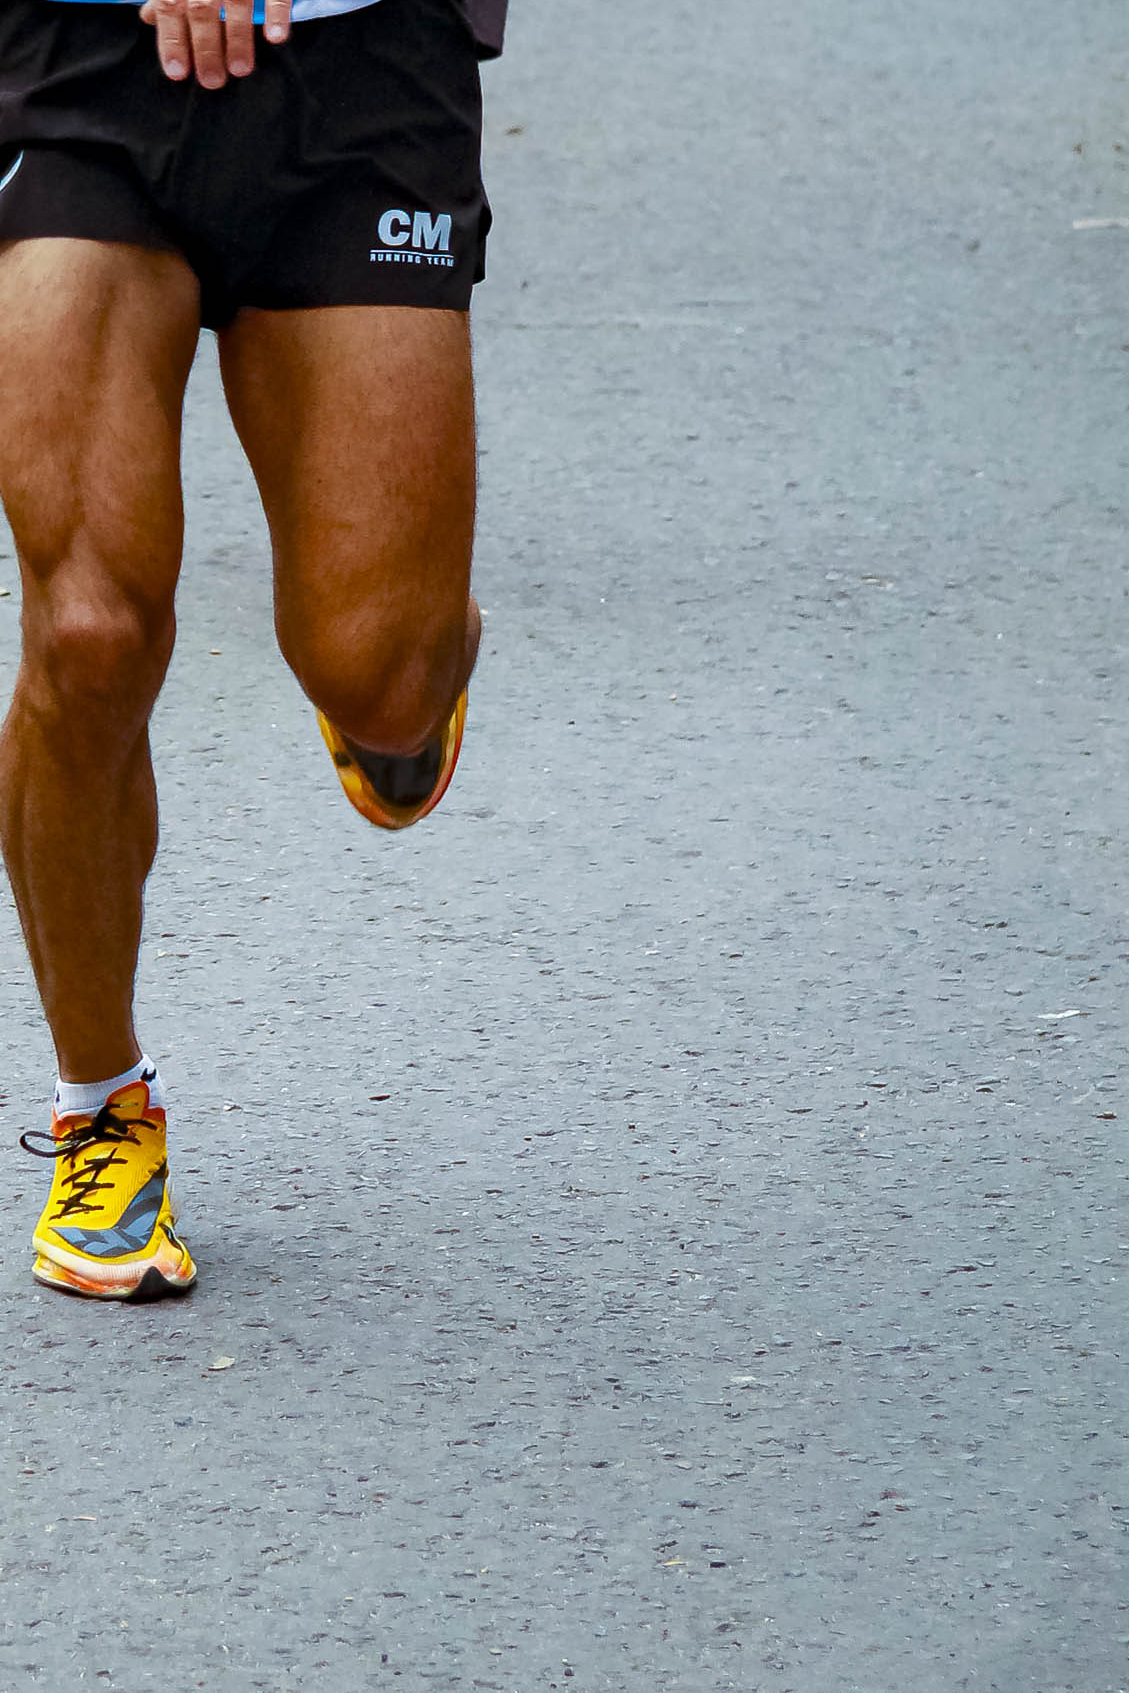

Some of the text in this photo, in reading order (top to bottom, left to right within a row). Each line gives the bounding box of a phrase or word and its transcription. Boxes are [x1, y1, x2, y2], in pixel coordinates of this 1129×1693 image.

[377, 209, 452, 251] CM
[370, 253, 454, 267] RUNNING TEAM
